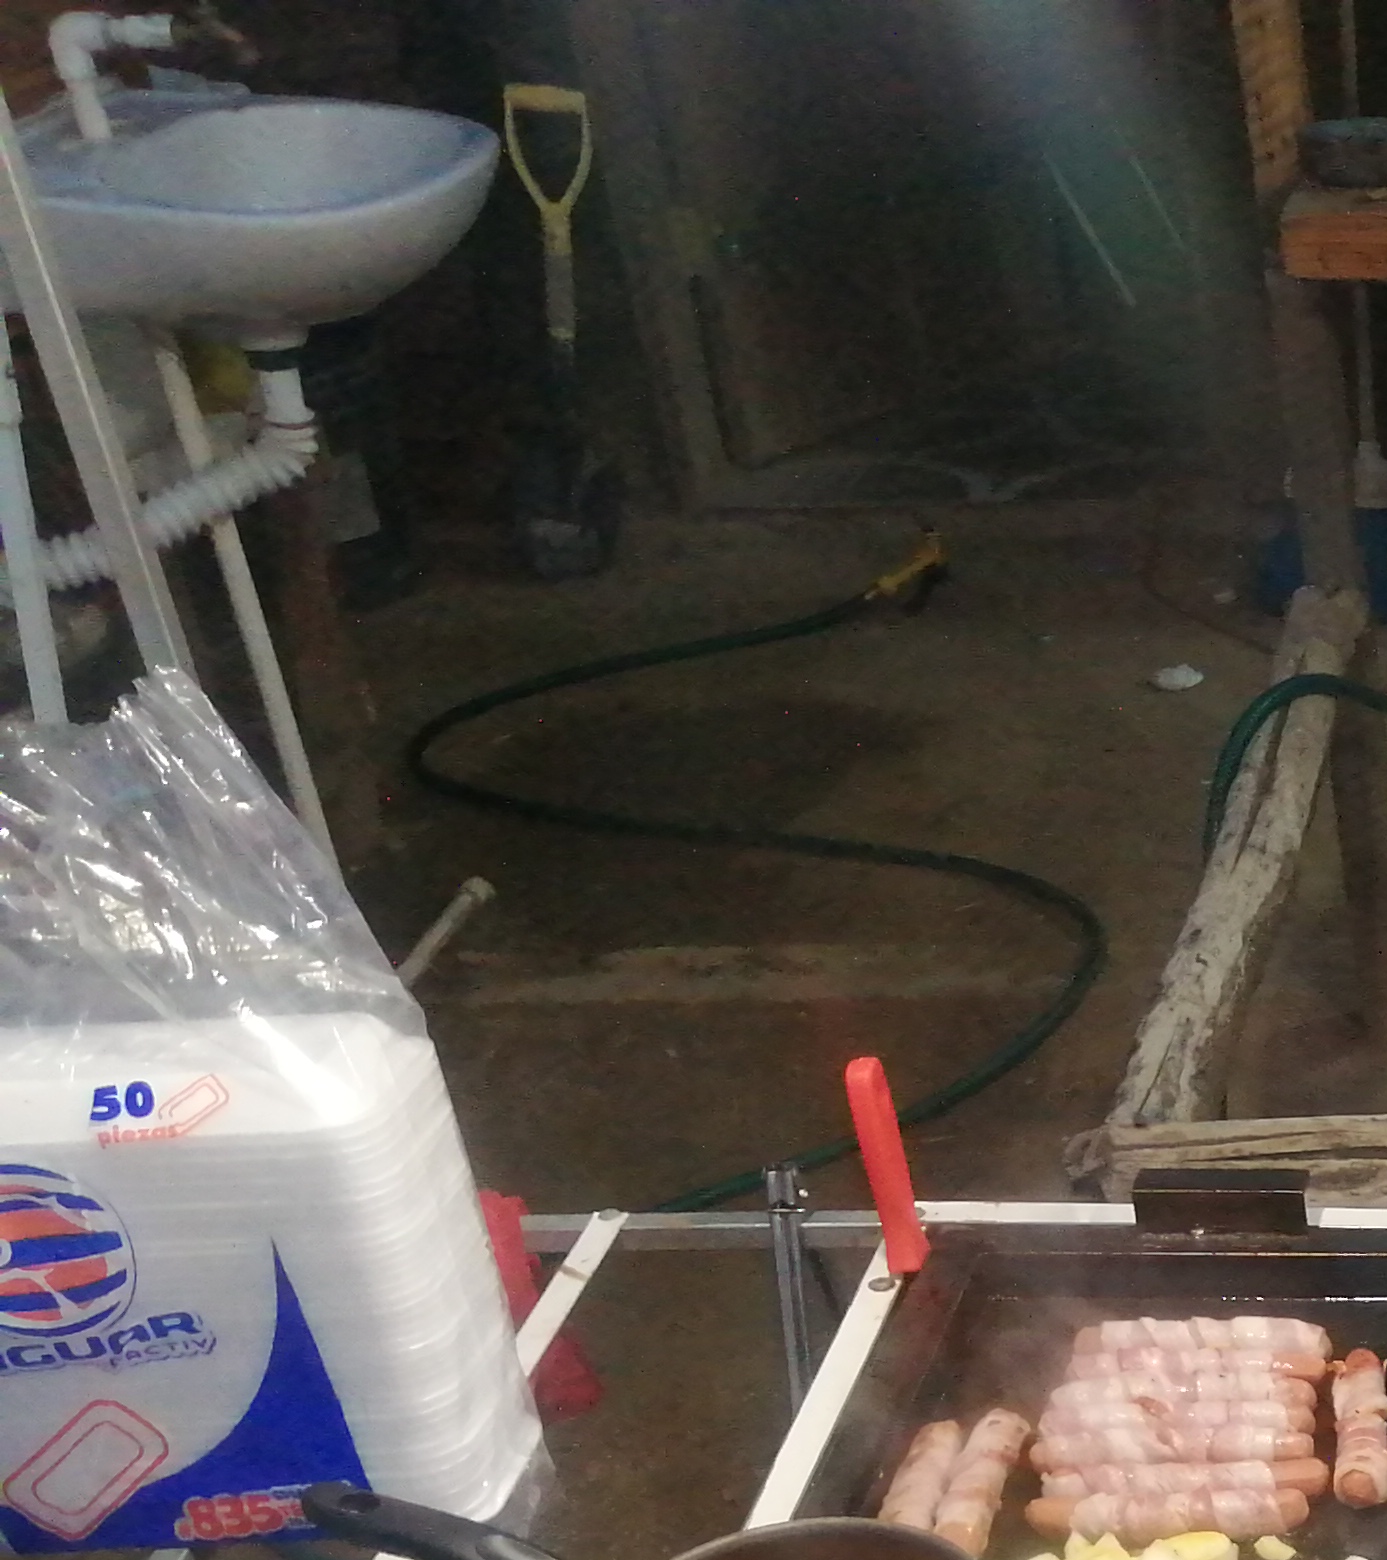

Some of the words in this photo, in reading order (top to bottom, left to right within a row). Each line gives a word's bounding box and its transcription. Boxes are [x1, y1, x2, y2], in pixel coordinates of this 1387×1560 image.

[90, 1080, 155, 1122] 50
[97, 1124, 179, 1149] piezas
[0, 1311, 201, 1370] GUAR
